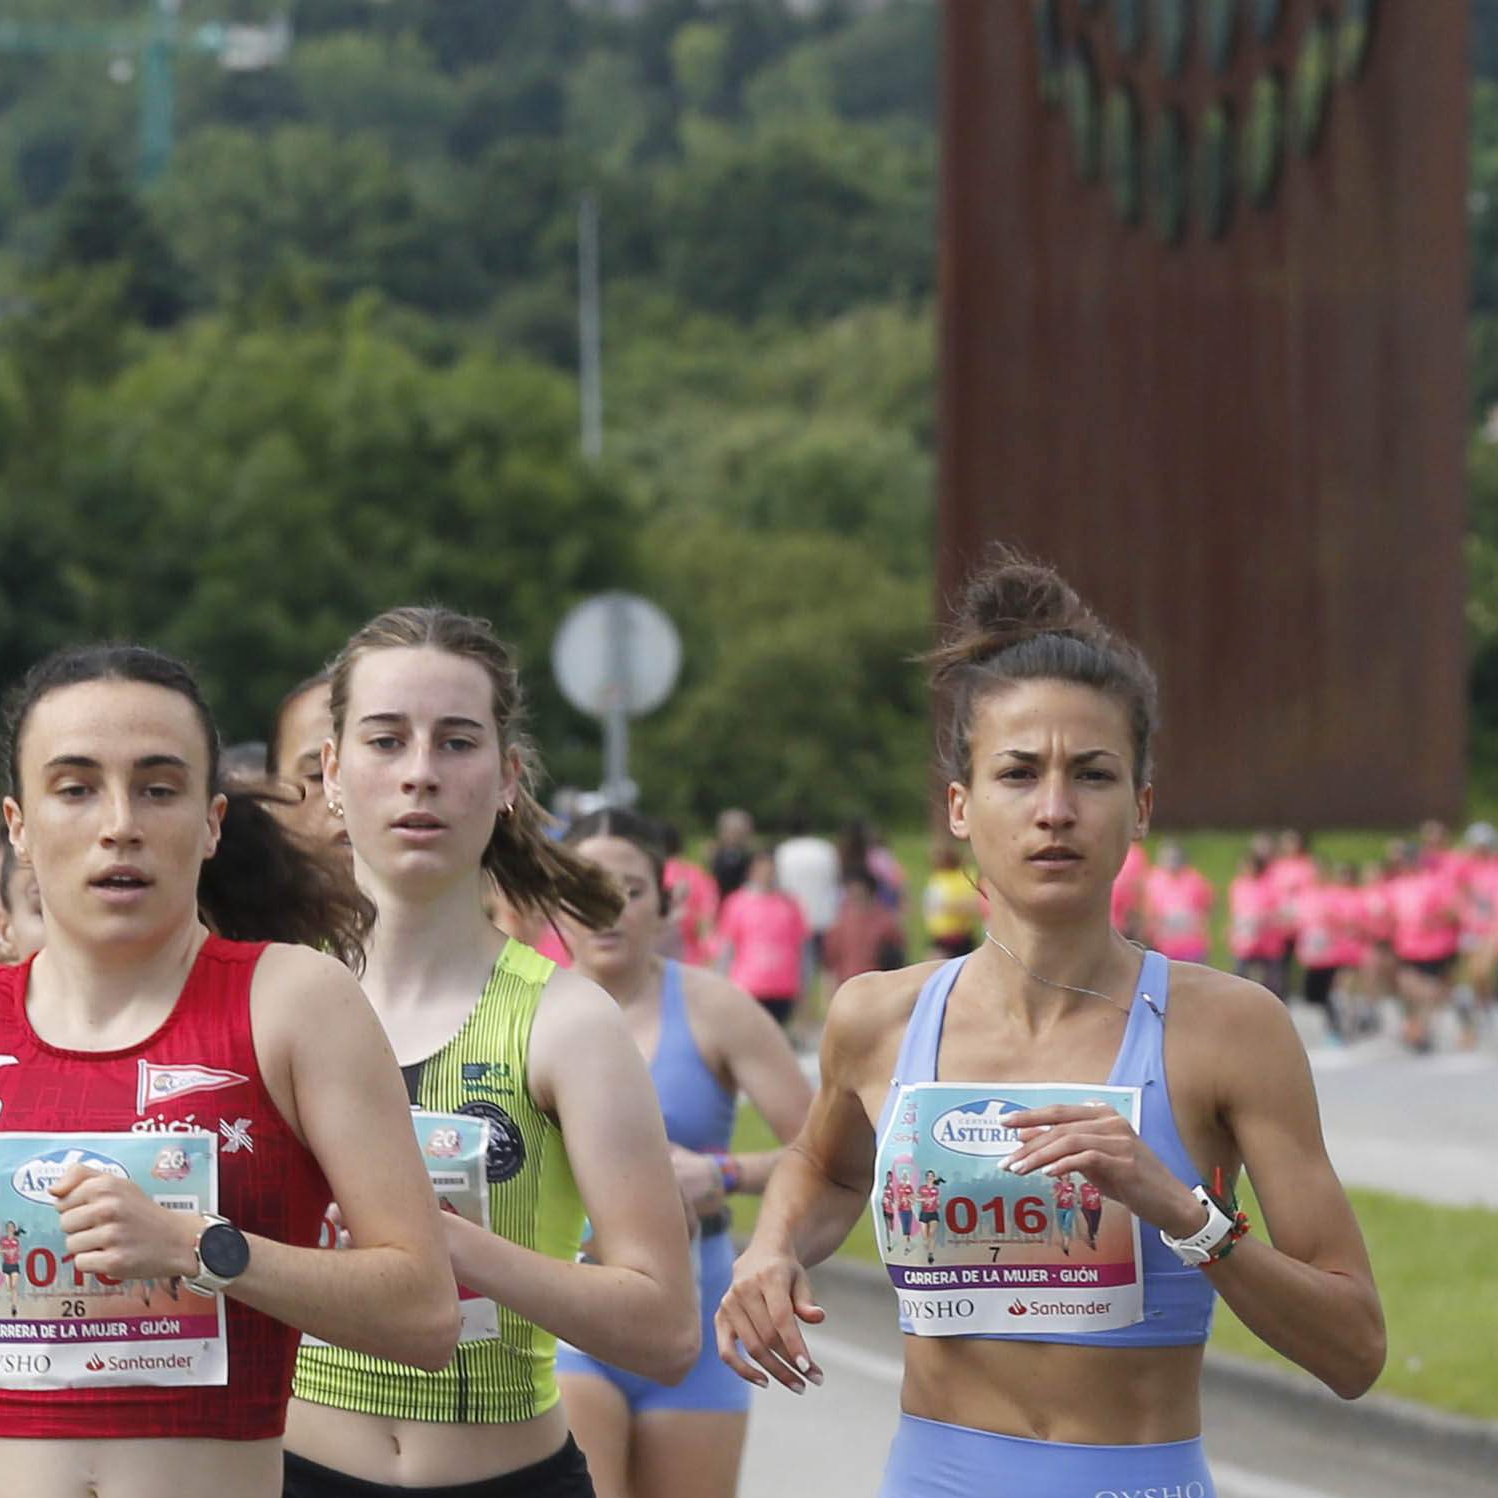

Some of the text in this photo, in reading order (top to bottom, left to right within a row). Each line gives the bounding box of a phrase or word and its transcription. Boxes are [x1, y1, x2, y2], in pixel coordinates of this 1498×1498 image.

[945, 1196, 1048, 1234] 016
[989, 1247, 1000, 1262] 7
[904, 1266, 1098, 1285] CARRERA DE LA MUJER GIJÓN
[61, 1301, 86, 1317] 26
[1030, 1301, 1112, 1316] Santander
[40, 1323, 56, 1338] DE
[60, 1323, 77, 1338] LA
[81, 1322, 128, 1337] MUJER
[140, 1317, 180, 1335] GIJÓN
[107, 1354, 193, 1371] Santander
